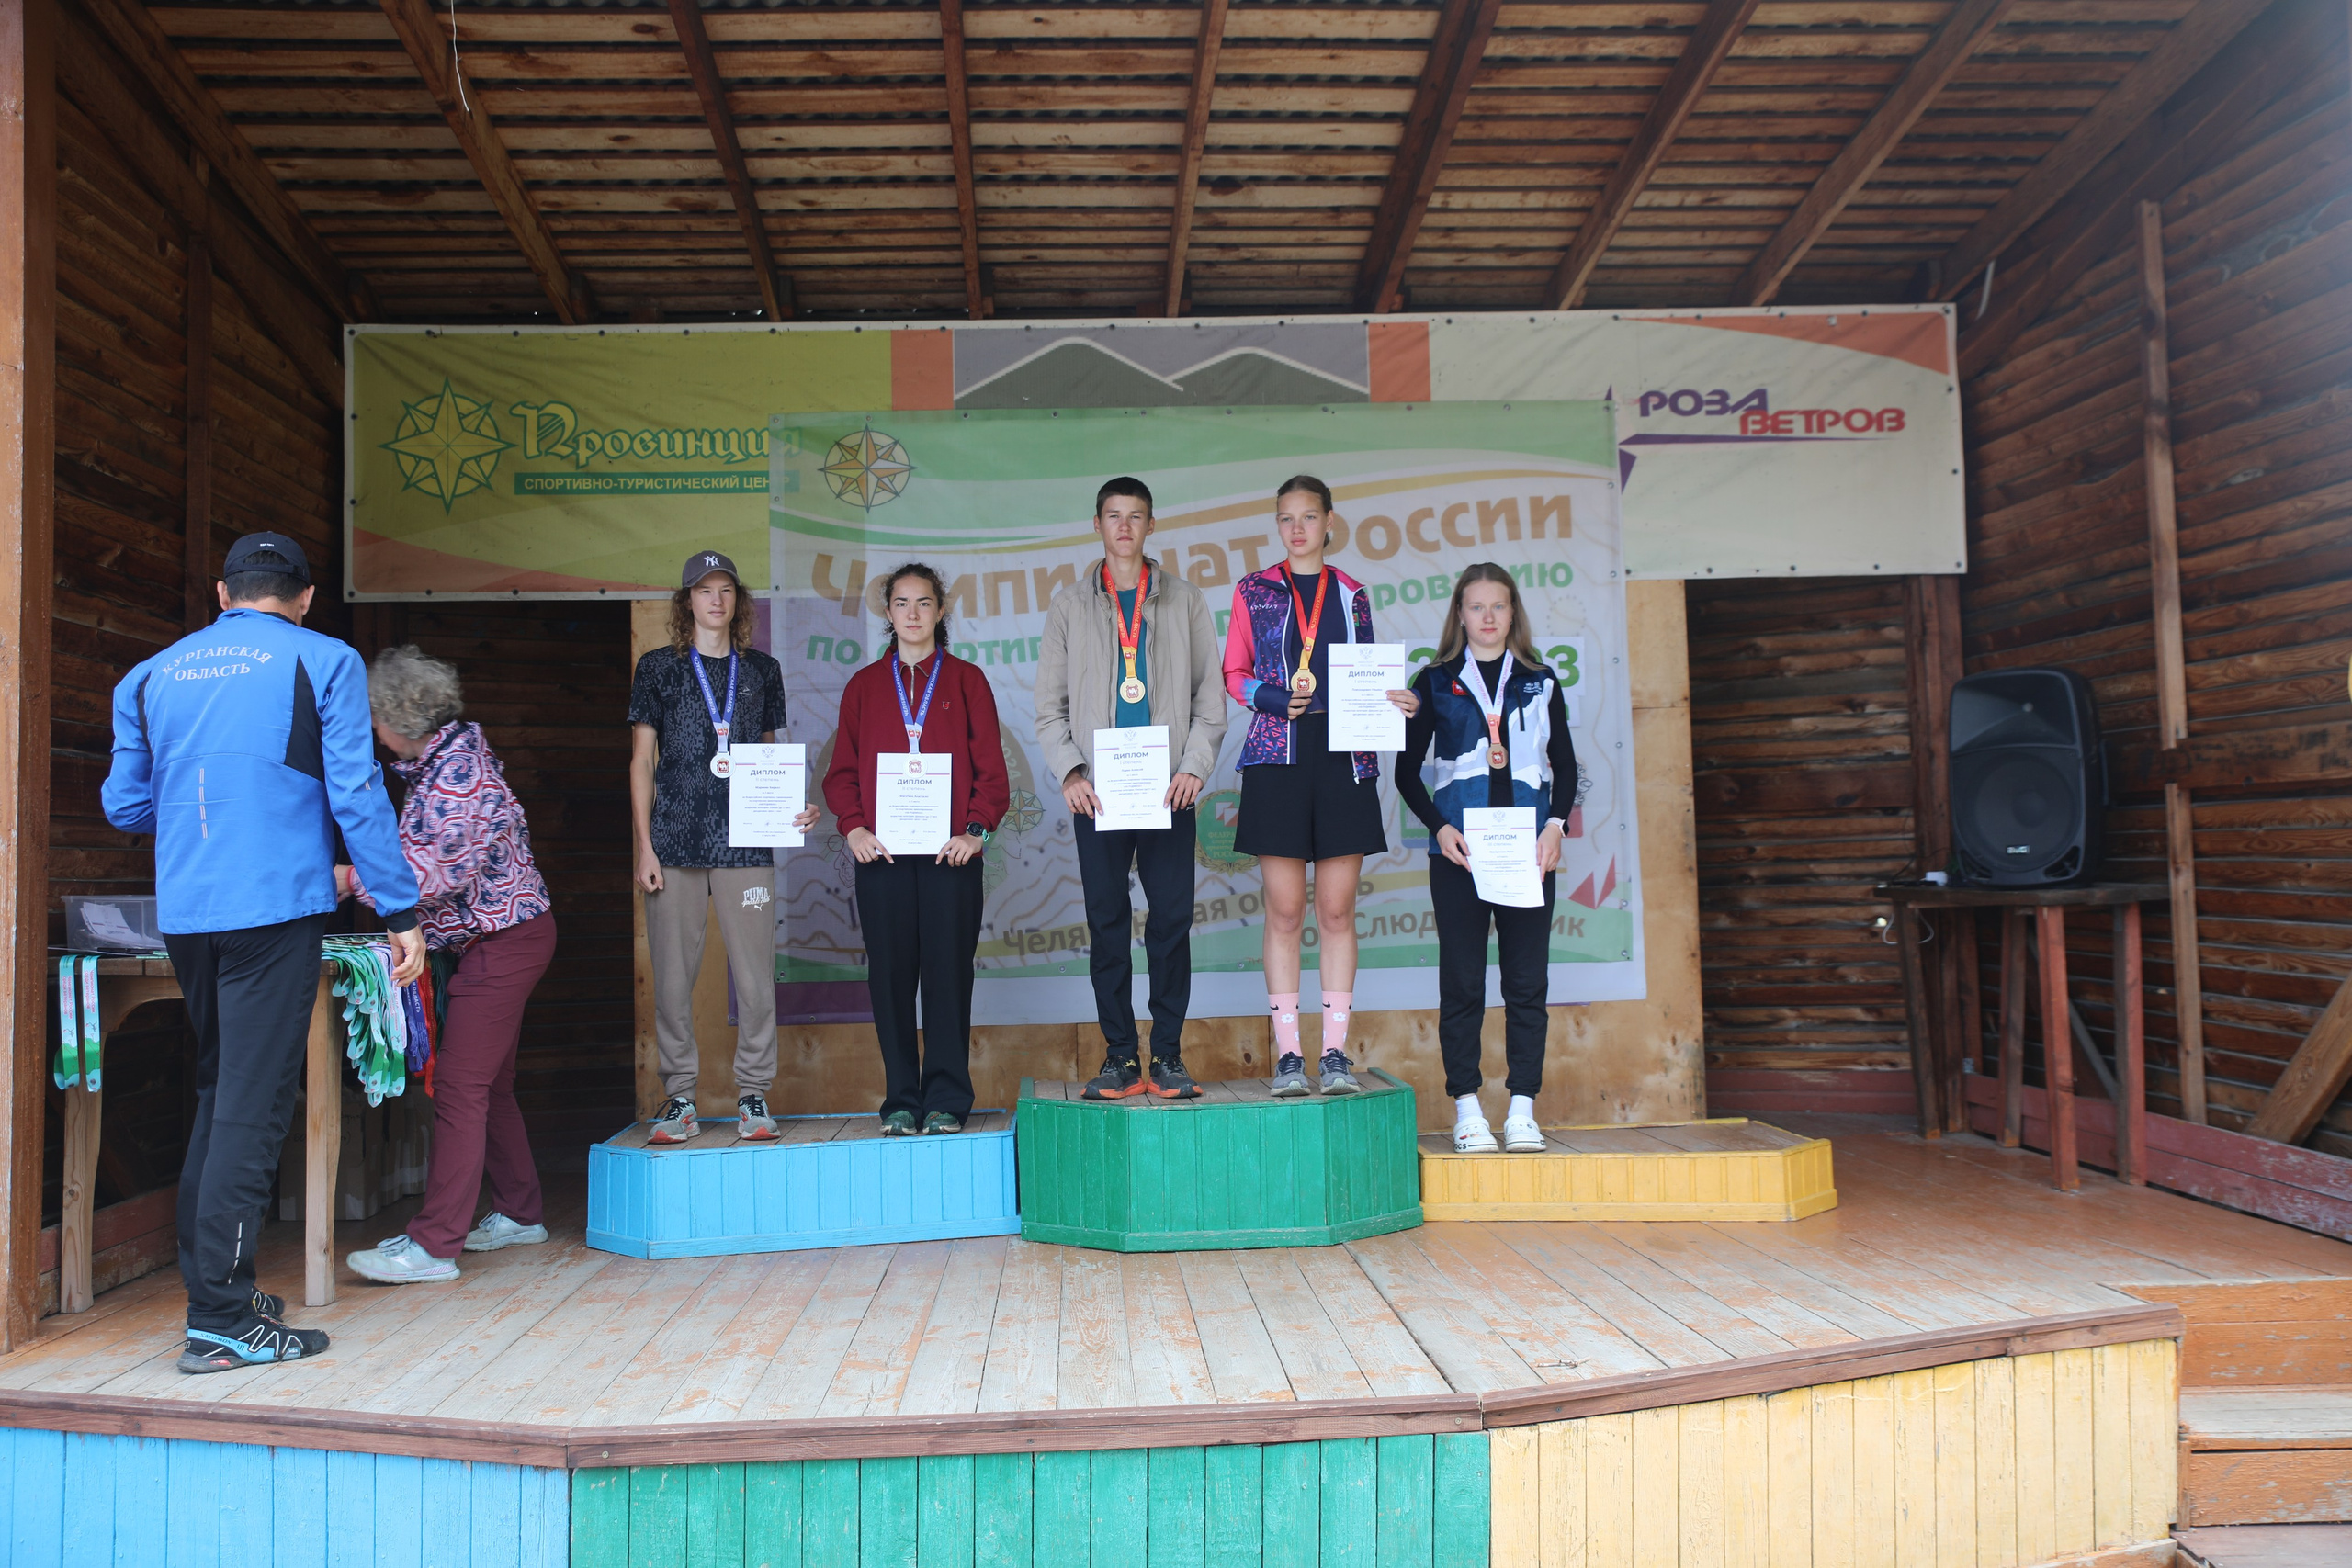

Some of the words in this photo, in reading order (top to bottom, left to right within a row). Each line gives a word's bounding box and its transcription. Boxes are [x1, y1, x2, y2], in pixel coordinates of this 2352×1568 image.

[1639, 388, 1768, 417] РОЗА
[1739, 408, 1906, 435] ВЕТРОВ
[524, 475, 740, 490] СПОРТИВНО-ТУРИСТИЧЕСКИЙ
[162, 646, 273, 675] КУРГАНСКАЯ
[175, 663, 251, 682] ОБЛАСТЬ
[1114, 751, 1149, 760] ДИПЛОМ
[743, 886, 770, 901] PUMA
[199, 1333, 232, 1345] SALOMON
